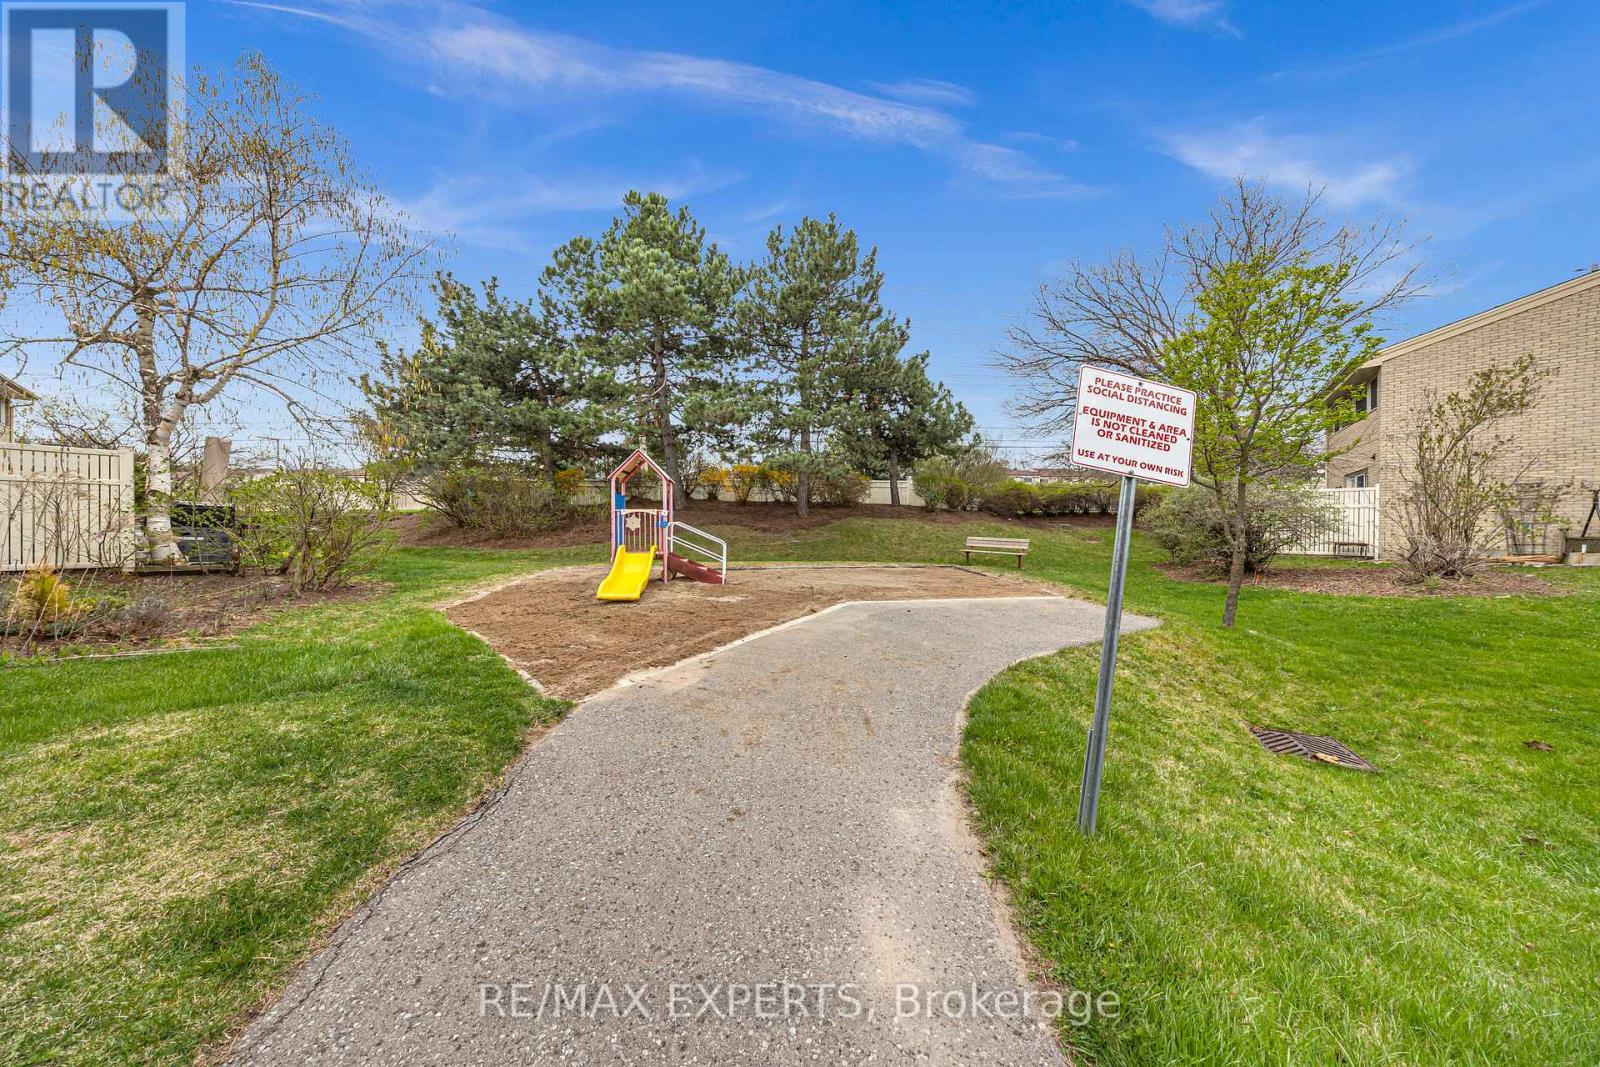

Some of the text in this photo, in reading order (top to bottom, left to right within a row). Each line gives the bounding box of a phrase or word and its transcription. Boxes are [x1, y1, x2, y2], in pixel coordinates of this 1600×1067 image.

[1087, 385, 1187, 416] SOCIAL DISTANCING
[1094, 377, 1182, 406] PLEASE PRACTICE
[1082, 405, 1187, 437] EQUIPMENT & AREA
[1091, 417, 1177, 444] IS NOT CLEANED
[1097, 429, 1171, 452] OR SANITIZED
[1077, 448, 1184, 478] USE AT YOUR OWN RISK
